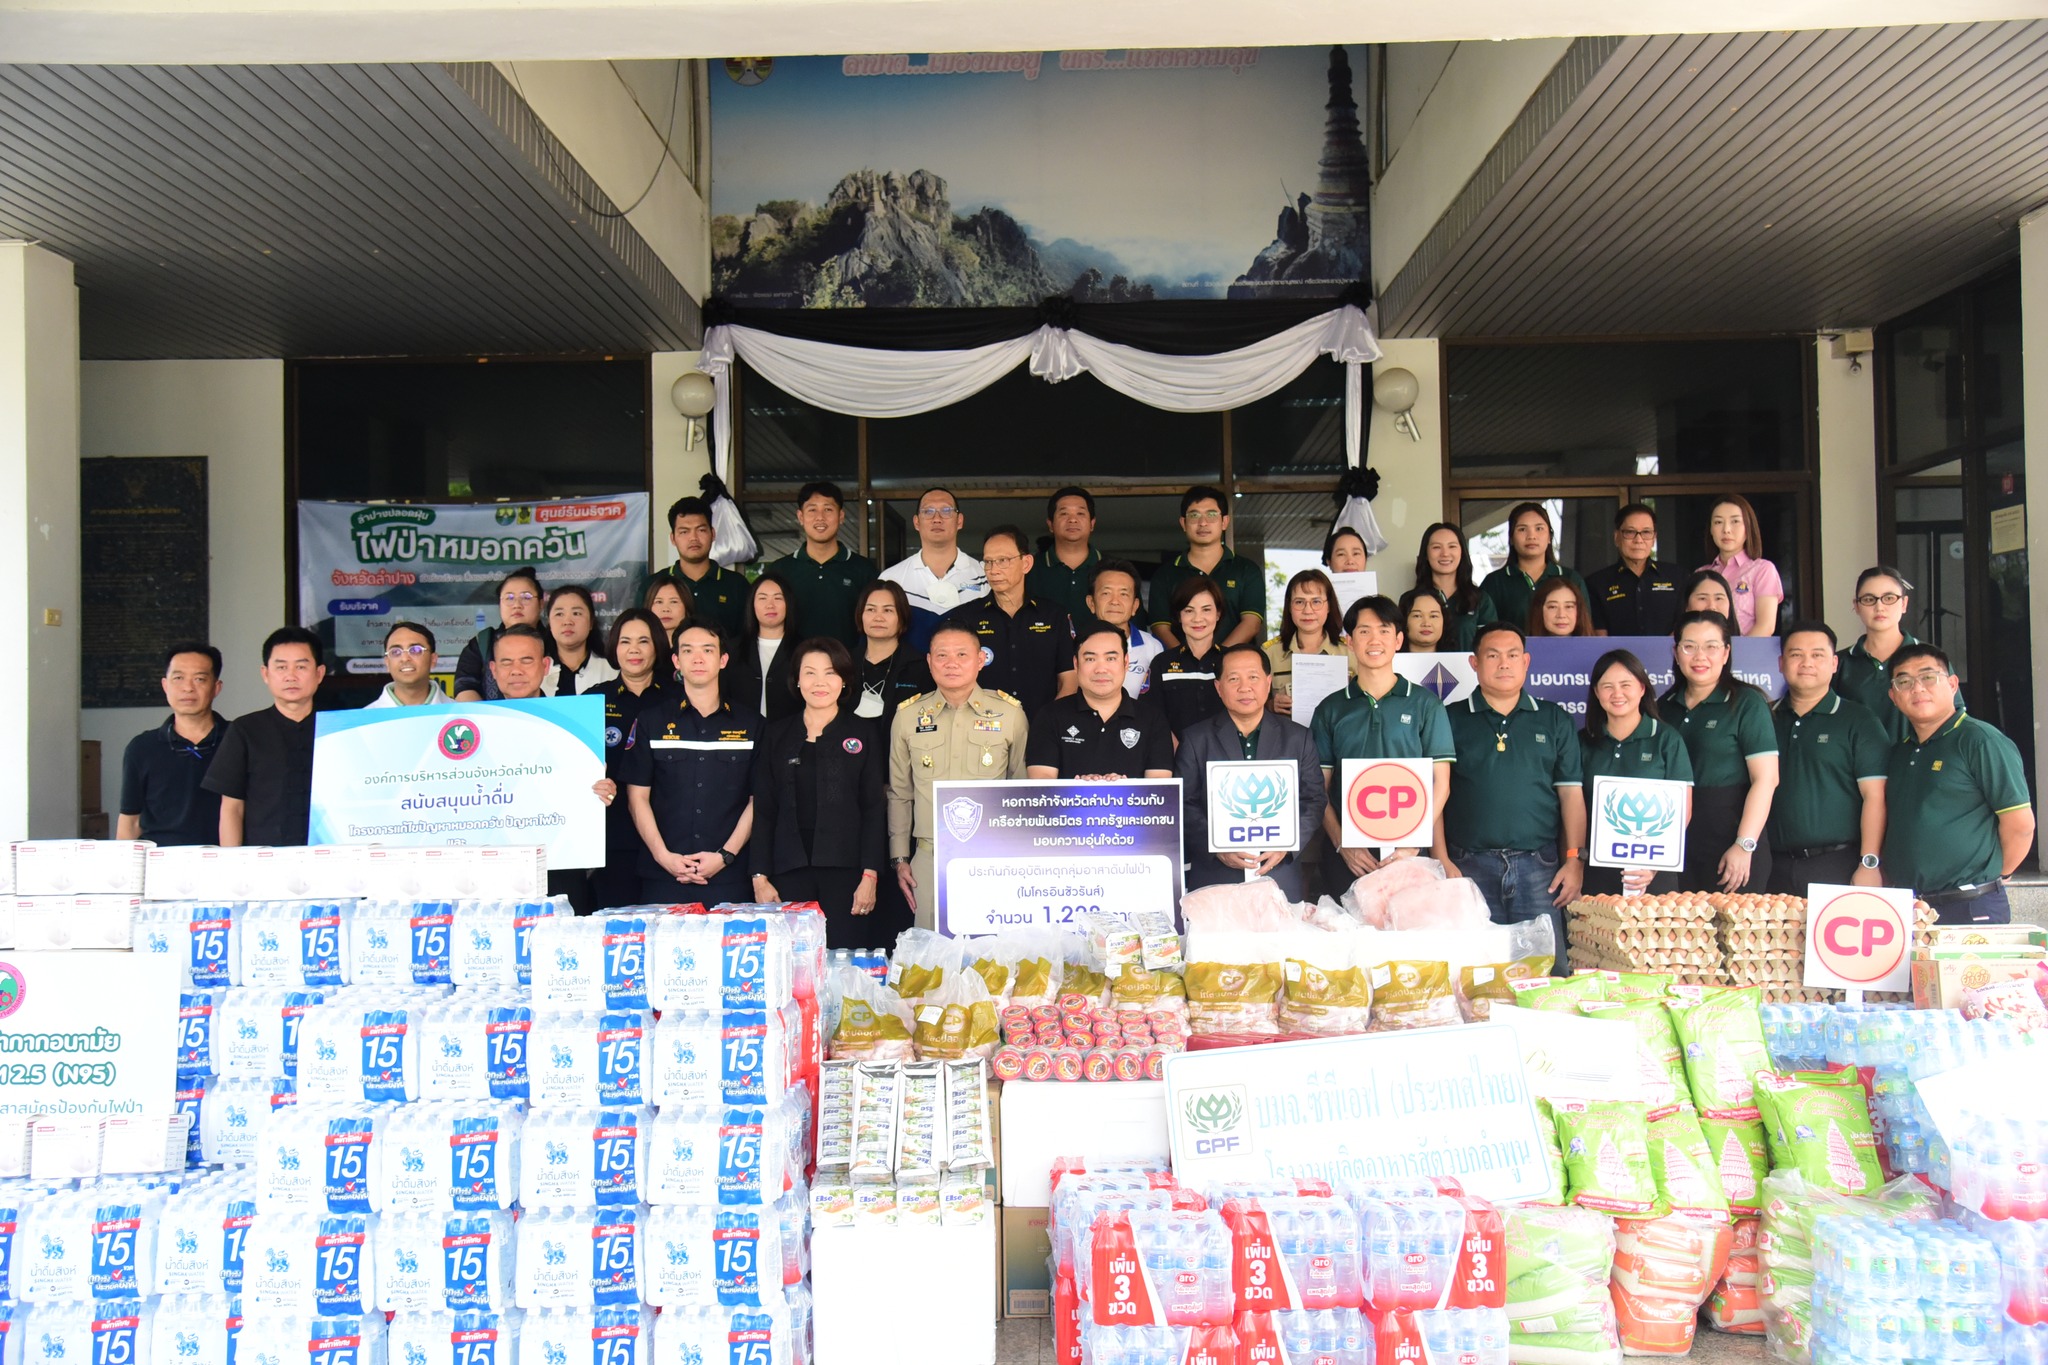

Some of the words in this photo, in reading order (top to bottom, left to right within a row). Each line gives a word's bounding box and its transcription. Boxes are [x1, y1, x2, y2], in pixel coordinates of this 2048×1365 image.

[356, 528, 586, 561] ไฟป่าหมอกควัน
[332, 568, 416, 586] จังหวัดลำปาง
[364, 764, 552, 785] องค์การบริหารส่วนจังหวัดลำปาง
[401, 784, 514, 814] สนับสนุนน้ำดื่ม
[1002, 796, 1123, 807] หอการค้าจังหวัดลำปาง
[1126, 794, 1164, 806] ร่วมกับ
[1356, 786, 1417, 819] CP
[349, 816, 504, 836] โครงการแก้ไขปัญหาหมอกควัน
[506, 812, 565, 828] ปัญหาไฟป่า
[989, 814, 1082, 828] เครือข่ายพันธมิตร
[1086, 815, 1174, 828] ภาครัฐและเอกชน
[1034, 833, 1134, 848] มอบความอุ่นใจด้วย
[1229, 826, 1280, 842] CPF
[1612, 842, 1664, 860] CPF
[968, 862, 1151, 878] ประกันภัยอุบัติเหตุกลุ่มอาสาดับไฟป่า
[1017, 886, 1104, 898] (ไมโครอินชัวรันส์)
[986, 910, 1032, 924] จำนวน
[194, 931, 224, 960] 15
[304, 928, 335, 958] 15
[415, 927, 446, 957] 15
[1824, 916, 1894, 957] CP
[608, 945, 642, 976] 15
[726, 946, 760, 978] 15
[1222, 976, 1242, 986] CP
[1307, 972, 1324, 984] CP
[1398, 972, 1416, 983] CP
[1506, 968, 1526, 978] CP
[852, 1012, 871, 1022] CP
[366, 1037, 399, 1067] 15
[491, 1034, 524, 1064] 15
[602, 1041, 636, 1075] 15
[725, 1039, 759, 1071] 15
[52, 1061, 116, 1087] (N95)
[598, 1139, 631, 1172] 15
[723, 1137, 756, 1169] 15
[1196, 1136, 1240, 1154] CPF
[331, 1146, 363, 1179] 15
[456, 1146, 490, 1179] 15
[2020, 1164, 2038, 1172] aro
[97, 1232, 132, 1266] 15
[1245, 1238, 1270, 1259] เพิ่ม
[1466, 1232, 1492, 1252] เพิ่ม
[320, 1246, 353, 1280] 15
[448, 1247, 483, 1280] 15
[597, 1237, 632, 1271] 15
[718, 1240, 752, 1272] 15
[1110, 1253, 1136, 1274] เพิ่ม
[1407, 1254, 1424, 1262] aro
[1250, 1260, 1266, 1285] 3
[1472, 1254, 1488, 1278] 3
[1114, 1276, 1130, 1300] 3
[1178, 1274, 1195, 1282] aro
[1467, 1280, 1494, 1292] ขวด
[1244, 1287, 1272, 1300] ขวด
[1108, 1302, 1136, 1316] ขวด
[96, 1330, 132, 1364] 15
[1250, 1339, 1276, 1360] เพิ่ม
[1395, 1338, 1420, 1360] เพิ่ม
[1460, 1354, 1477, 1363] aro
